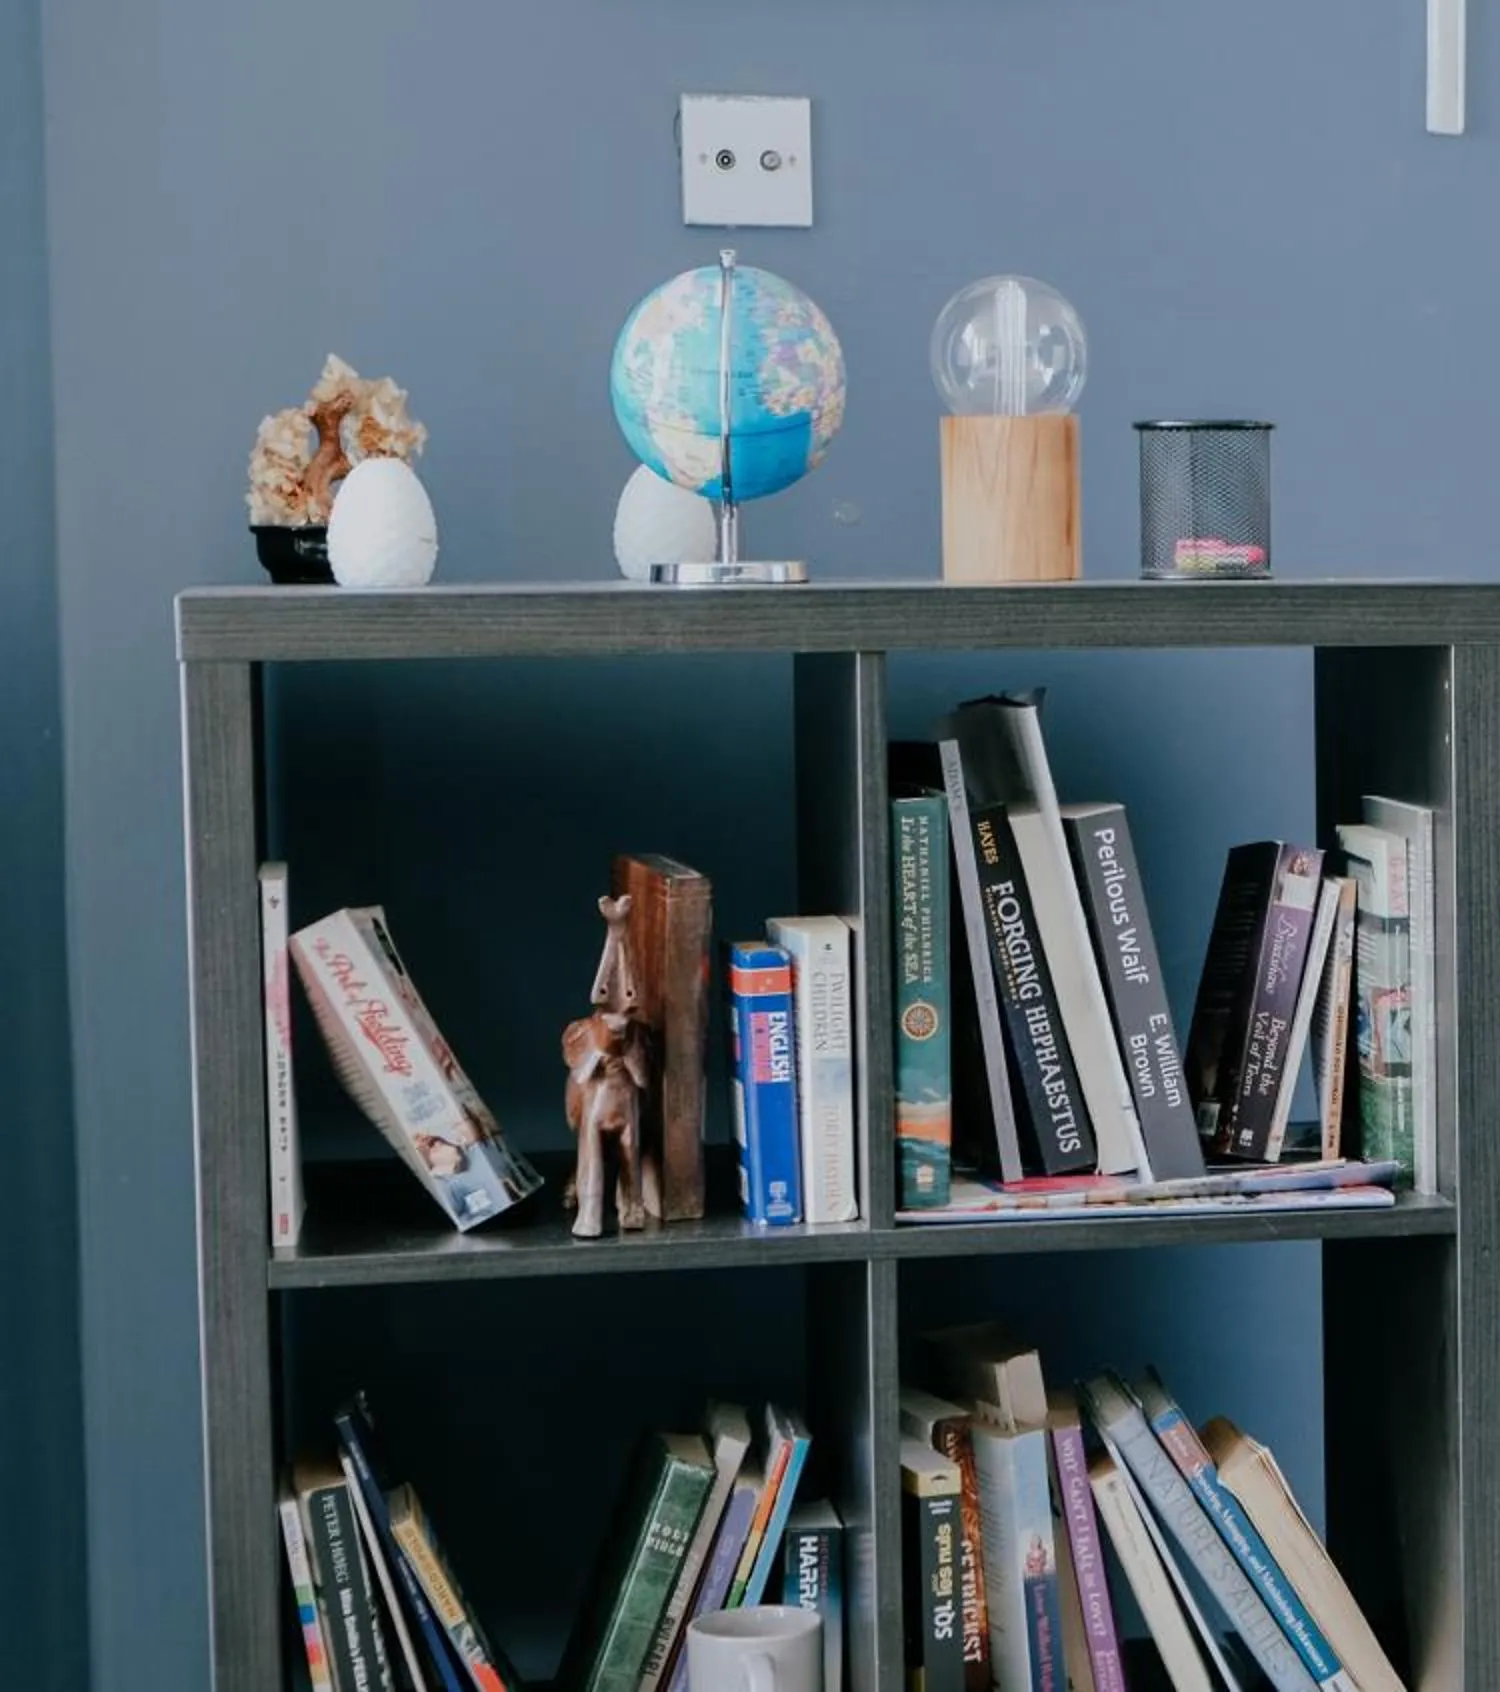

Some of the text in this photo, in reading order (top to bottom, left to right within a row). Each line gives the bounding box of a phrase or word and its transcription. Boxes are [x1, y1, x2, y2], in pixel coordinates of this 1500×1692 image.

[977, 821, 999, 865] HAYES
[902, 856, 917, 914] HEART
[1094, 828, 1149, 985] Perilous Waif
[904, 952, 918, 985] SEA
[768, 1011, 791, 1083] ENGLISH
[811, 971, 828, 1050] CHILDREN
[830, 972, 848, 1050] TWILIGHT
[991, 879, 1081, 1153] FORGING HEPHAESTUS
[1129, 1033, 1156, 1099] Brown
[1149, 1012, 1182, 1108] E. William
[1243, 1011, 1269, 1097] Veil of Tears
[1257, 1015, 1287, 1096] Beyond the
[1061, 1437, 1076, 1471] WHY
[322, 1495, 341, 1541] PETER
[799, 1535, 819, 1612] HARRA
[934, 1522, 954, 1640] SQL les nuls
[1148, 1454, 1288, 1677] NATURE'S ALLIES
